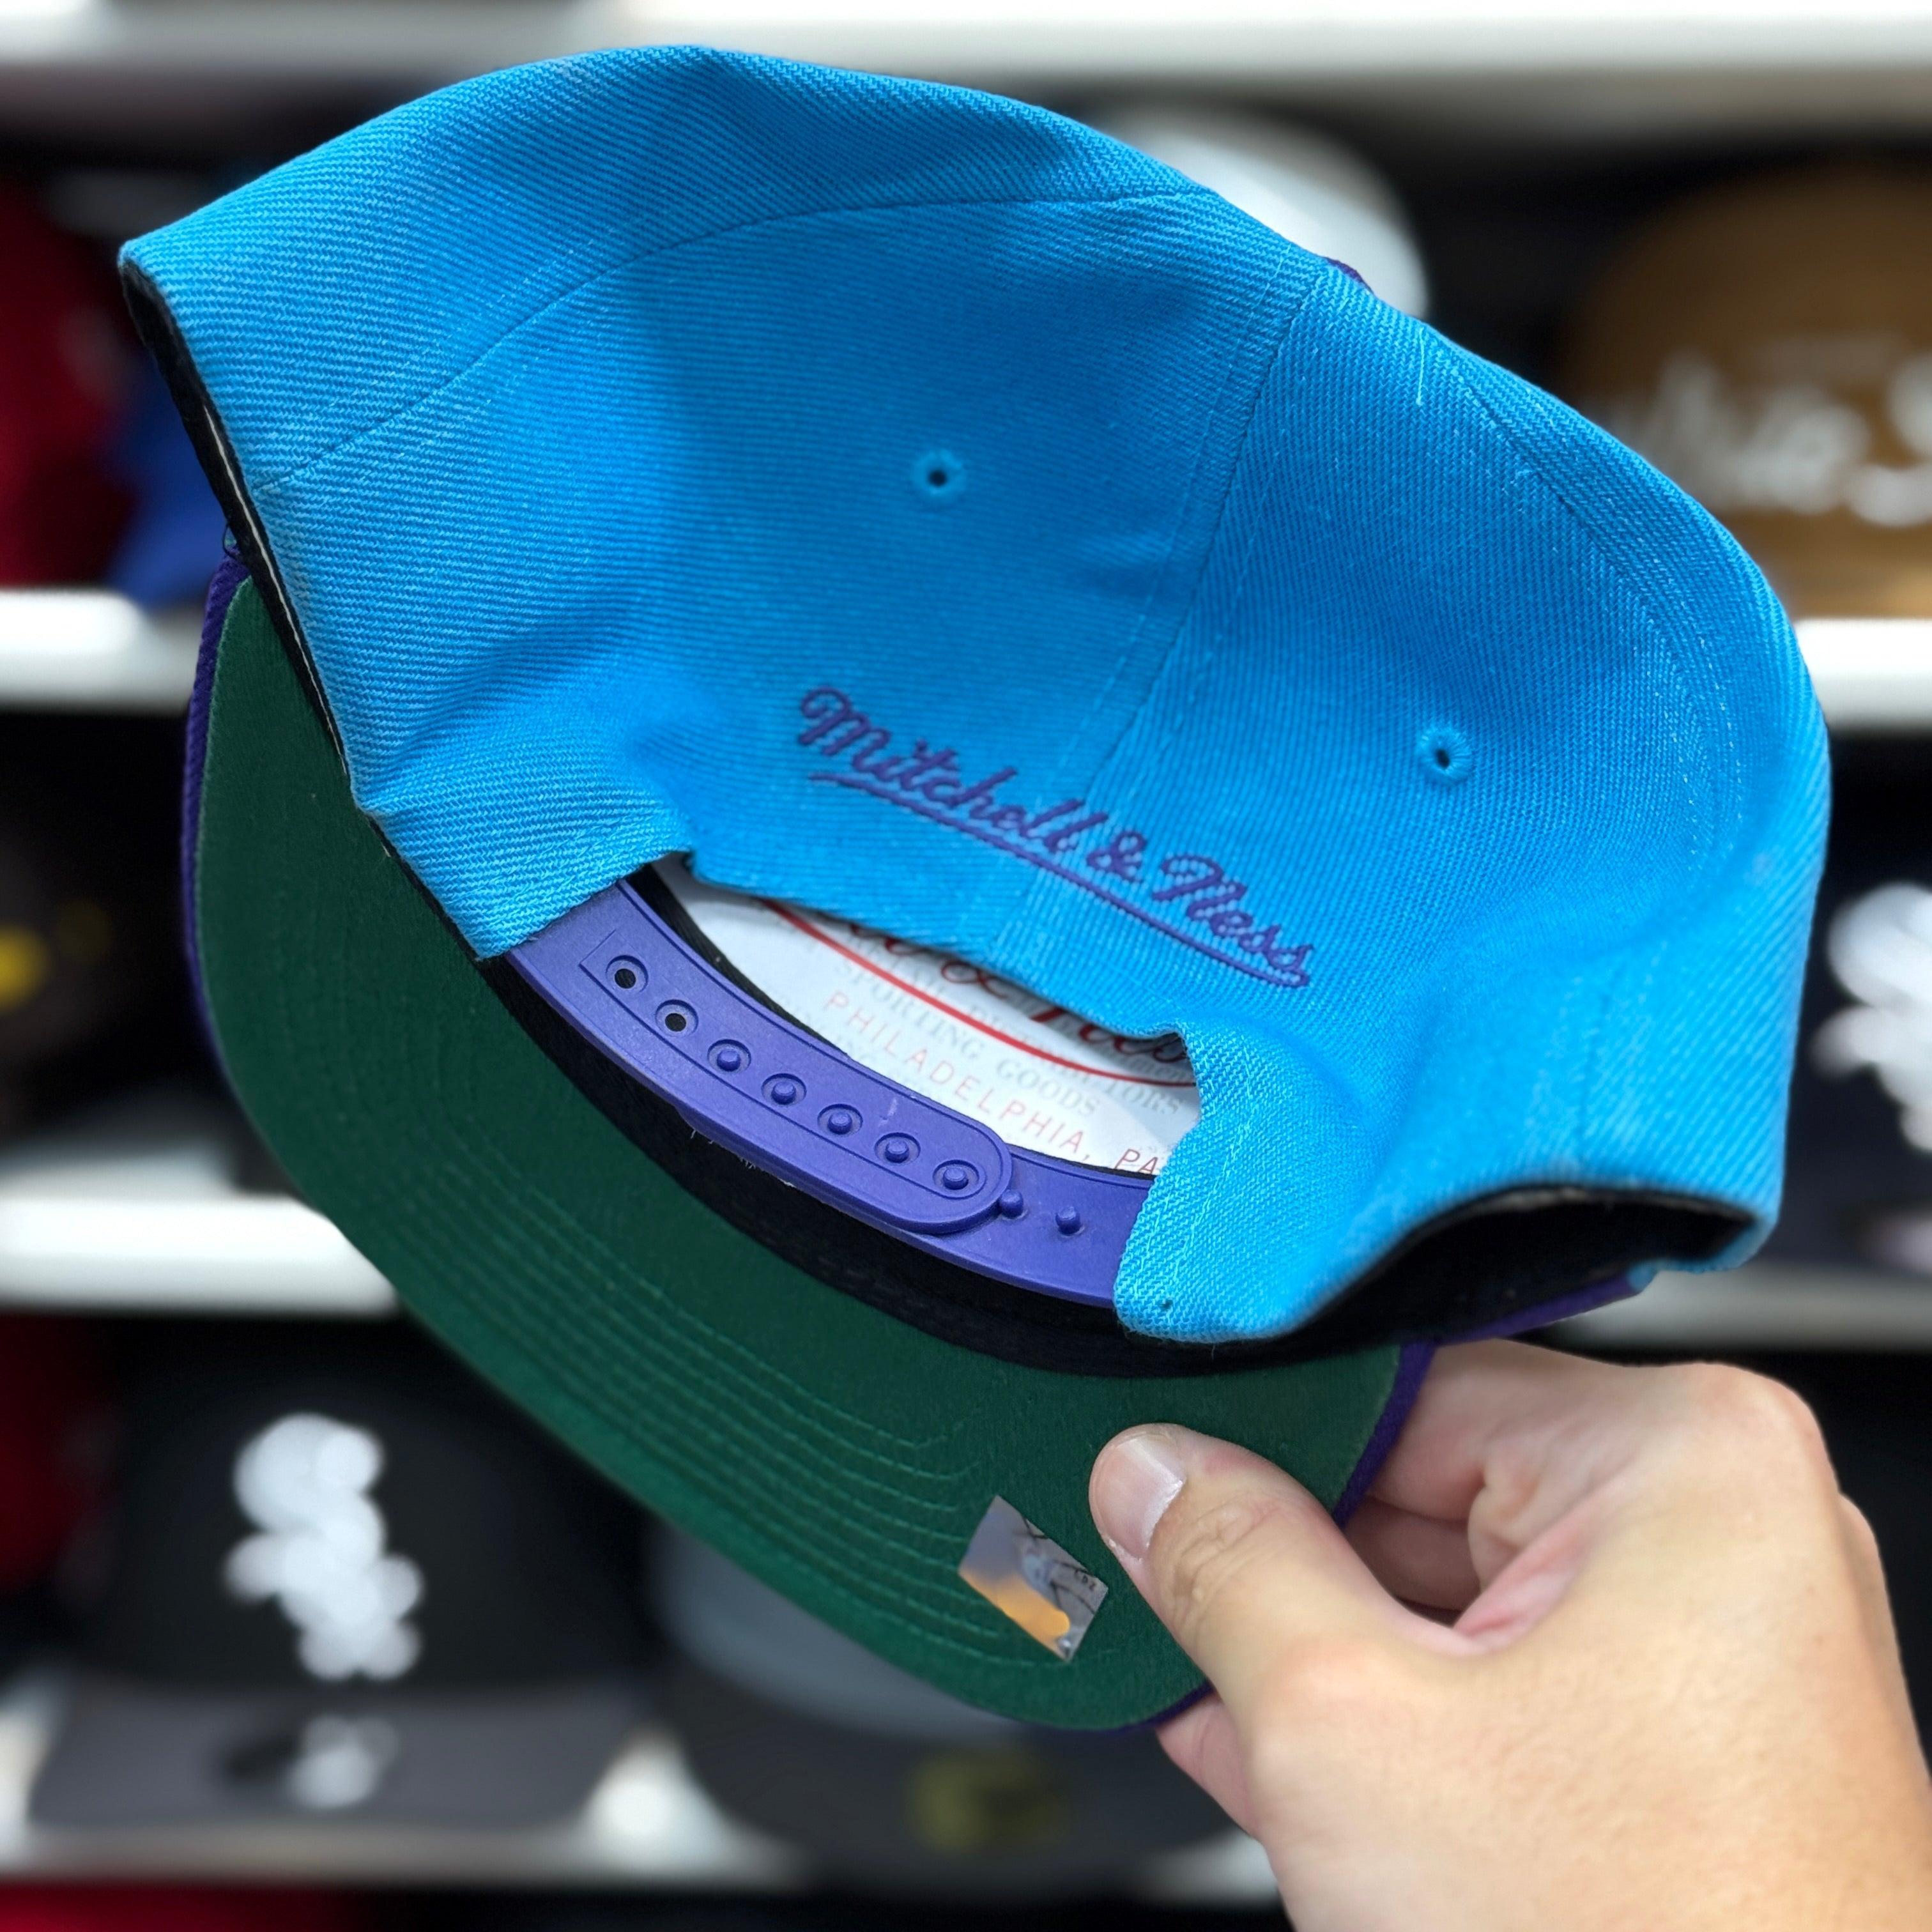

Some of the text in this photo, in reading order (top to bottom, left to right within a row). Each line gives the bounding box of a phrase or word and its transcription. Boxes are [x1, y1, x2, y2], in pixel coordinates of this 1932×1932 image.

[797, 686, 1315, 986] Mitchell & Ness
[823, 990, 1091, 1162] PHILADELPHIA,
[996, 1058, 1100, 1117] GOODS
